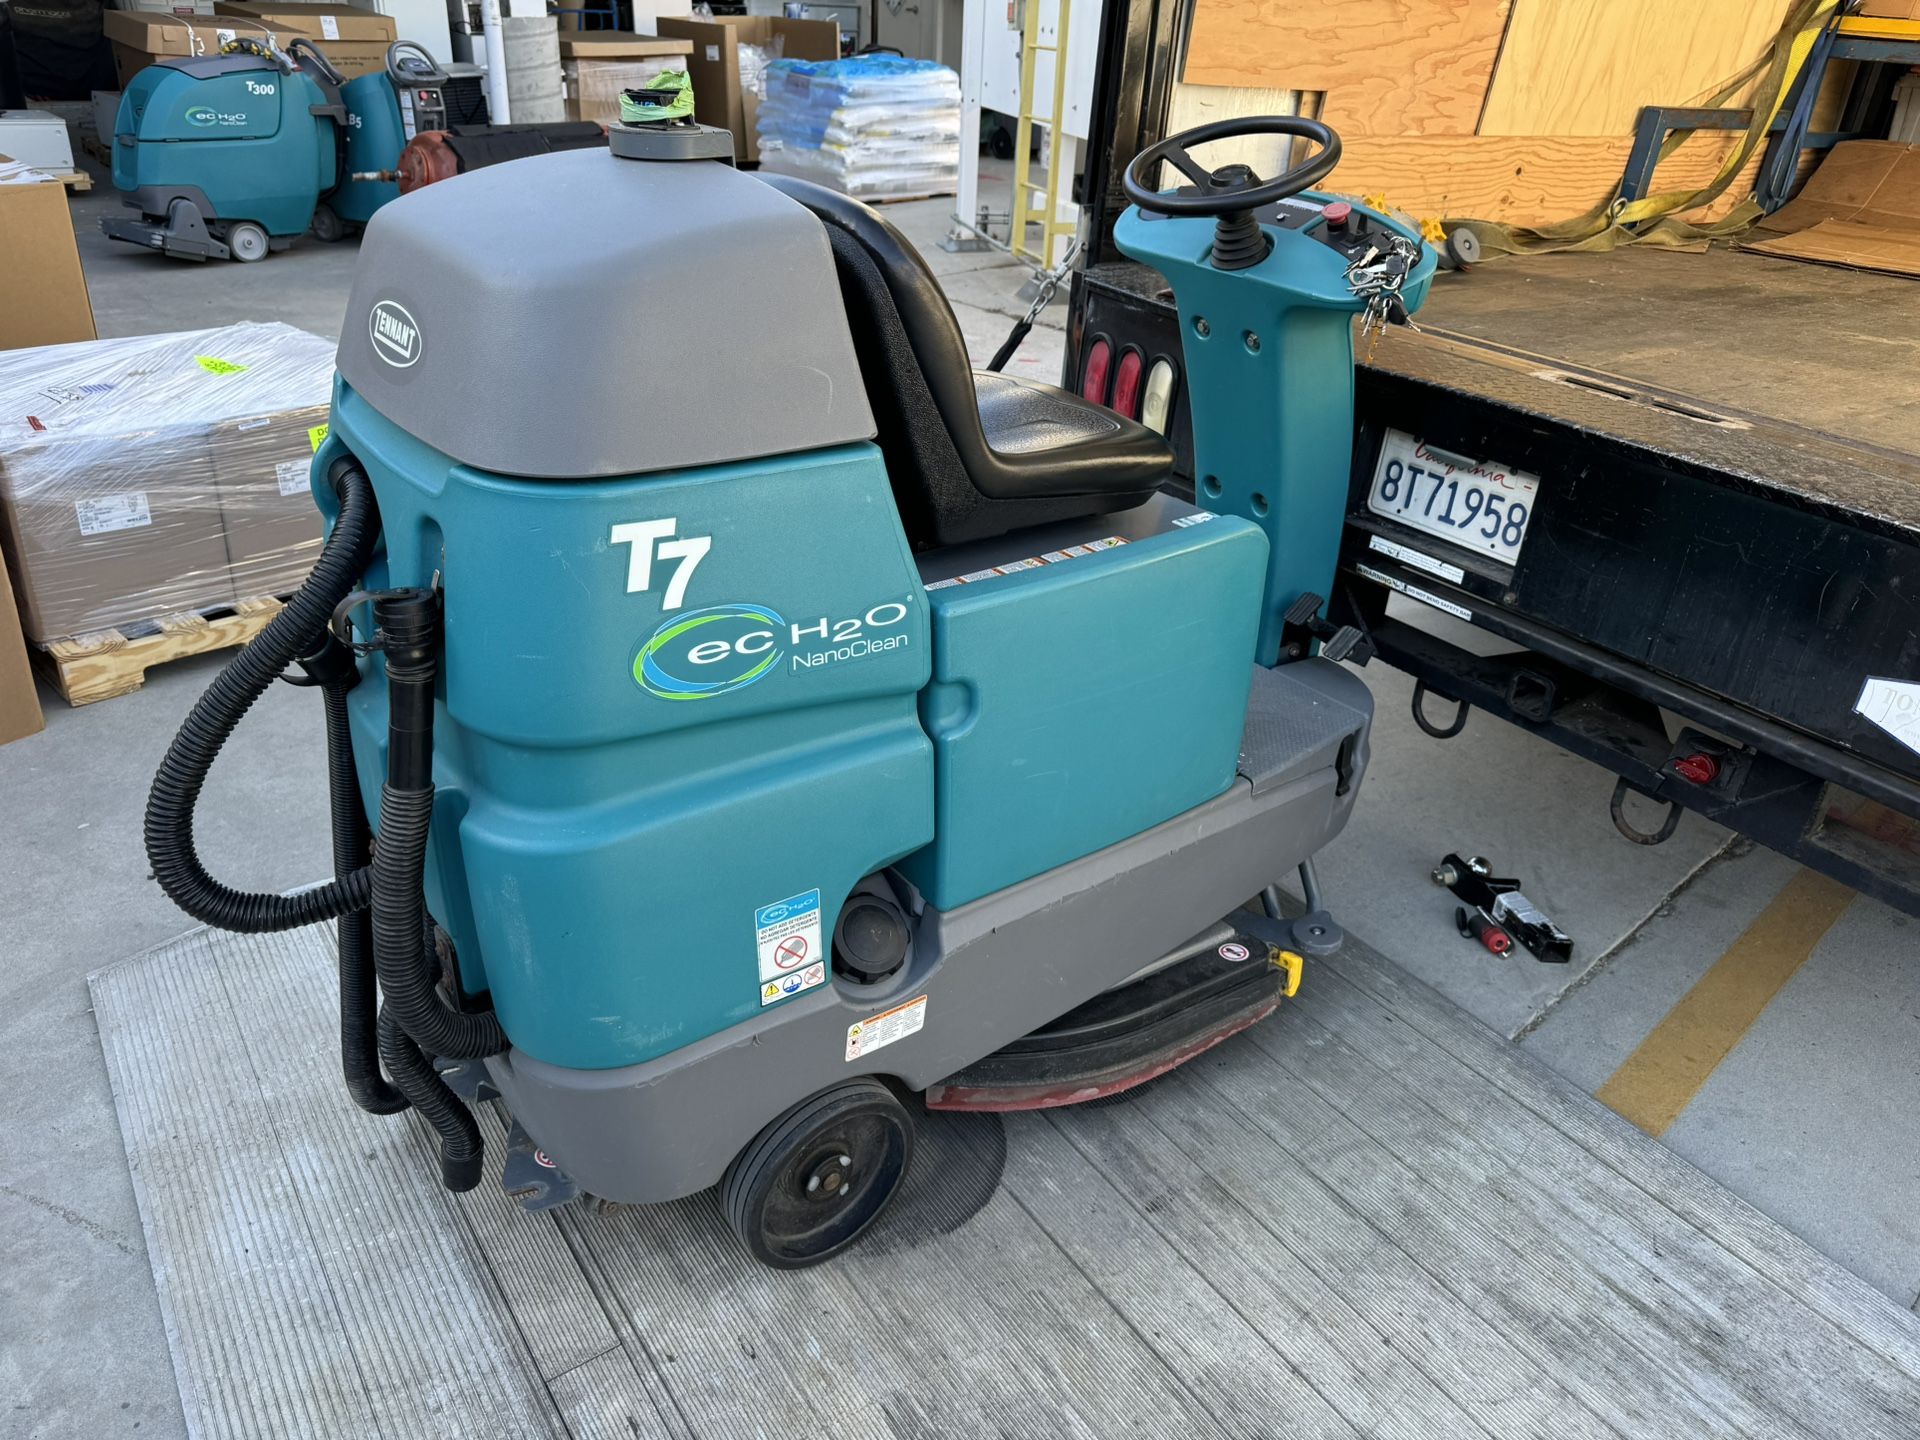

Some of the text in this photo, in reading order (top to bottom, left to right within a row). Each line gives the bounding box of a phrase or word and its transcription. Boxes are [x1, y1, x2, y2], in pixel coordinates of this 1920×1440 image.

[246, 81, 275, 95] T300
[349, 114, 362, 128] B5
[374, 307, 416, 358] TENNANT
[1381, 460, 1527, 547] 8T71958
[611, 517, 712, 611] T7
[1362, 568, 1392, 584] WARNING
[687, 630, 775, 664] ec
[792, 634, 908, 671] NanoClean
